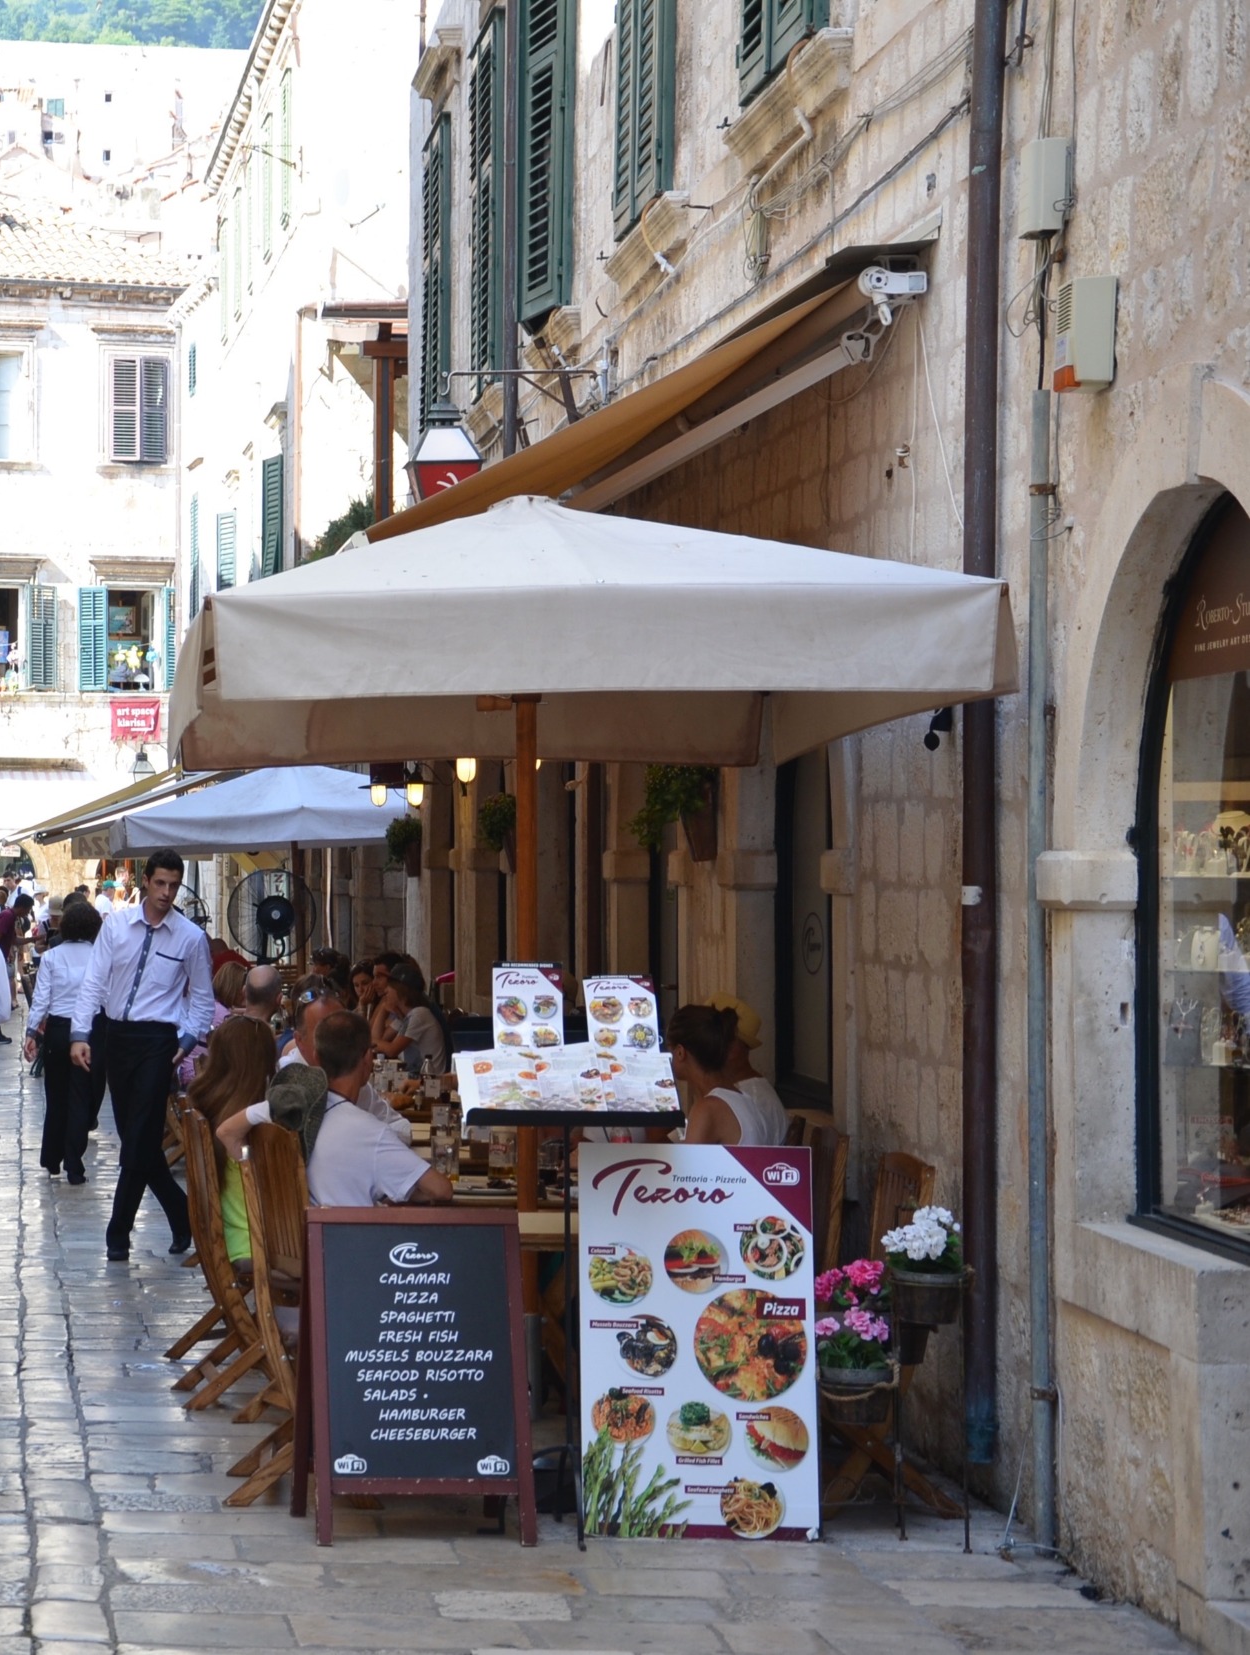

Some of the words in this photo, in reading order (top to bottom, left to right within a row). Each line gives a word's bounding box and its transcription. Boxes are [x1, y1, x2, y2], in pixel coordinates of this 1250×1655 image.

[1207, 639, 1229, 650] JEWELRY
[117, 707, 130, 716] art
[131, 708, 154, 718] space
[495, 971, 538, 989] Tezoro
[672, 1174, 708, 1184] Trattoria
[715, 1175, 747, 1184] Pizzeria
[592, 1158, 734, 1216] Tezoro
[379, 1273, 450, 1284] CALAMARI
[715, 1275, 744, 1283] Hamburger
[394, 1292, 438, 1304] PIZZA
[763, 1302, 800, 1316] Pizza
[380, 1311, 455, 1323] SPAGHETTI
[378, 1330, 422, 1343] FRESH
[428, 1330, 458, 1343] FISH
[345, 1350, 409, 1362] MUSSELS
[415, 1350, 493, 1362] BOUZZARA
[356, 1369, 419, 1382] SEAFOOD
[425, 1369, 484, 1381] RISOTTO
[363, 1389, 417, 1401] SALADS
[379, 1408, 465, 1421] HAMBURGER
[370, 1428, 477, 1440] CHEESEBURGER
